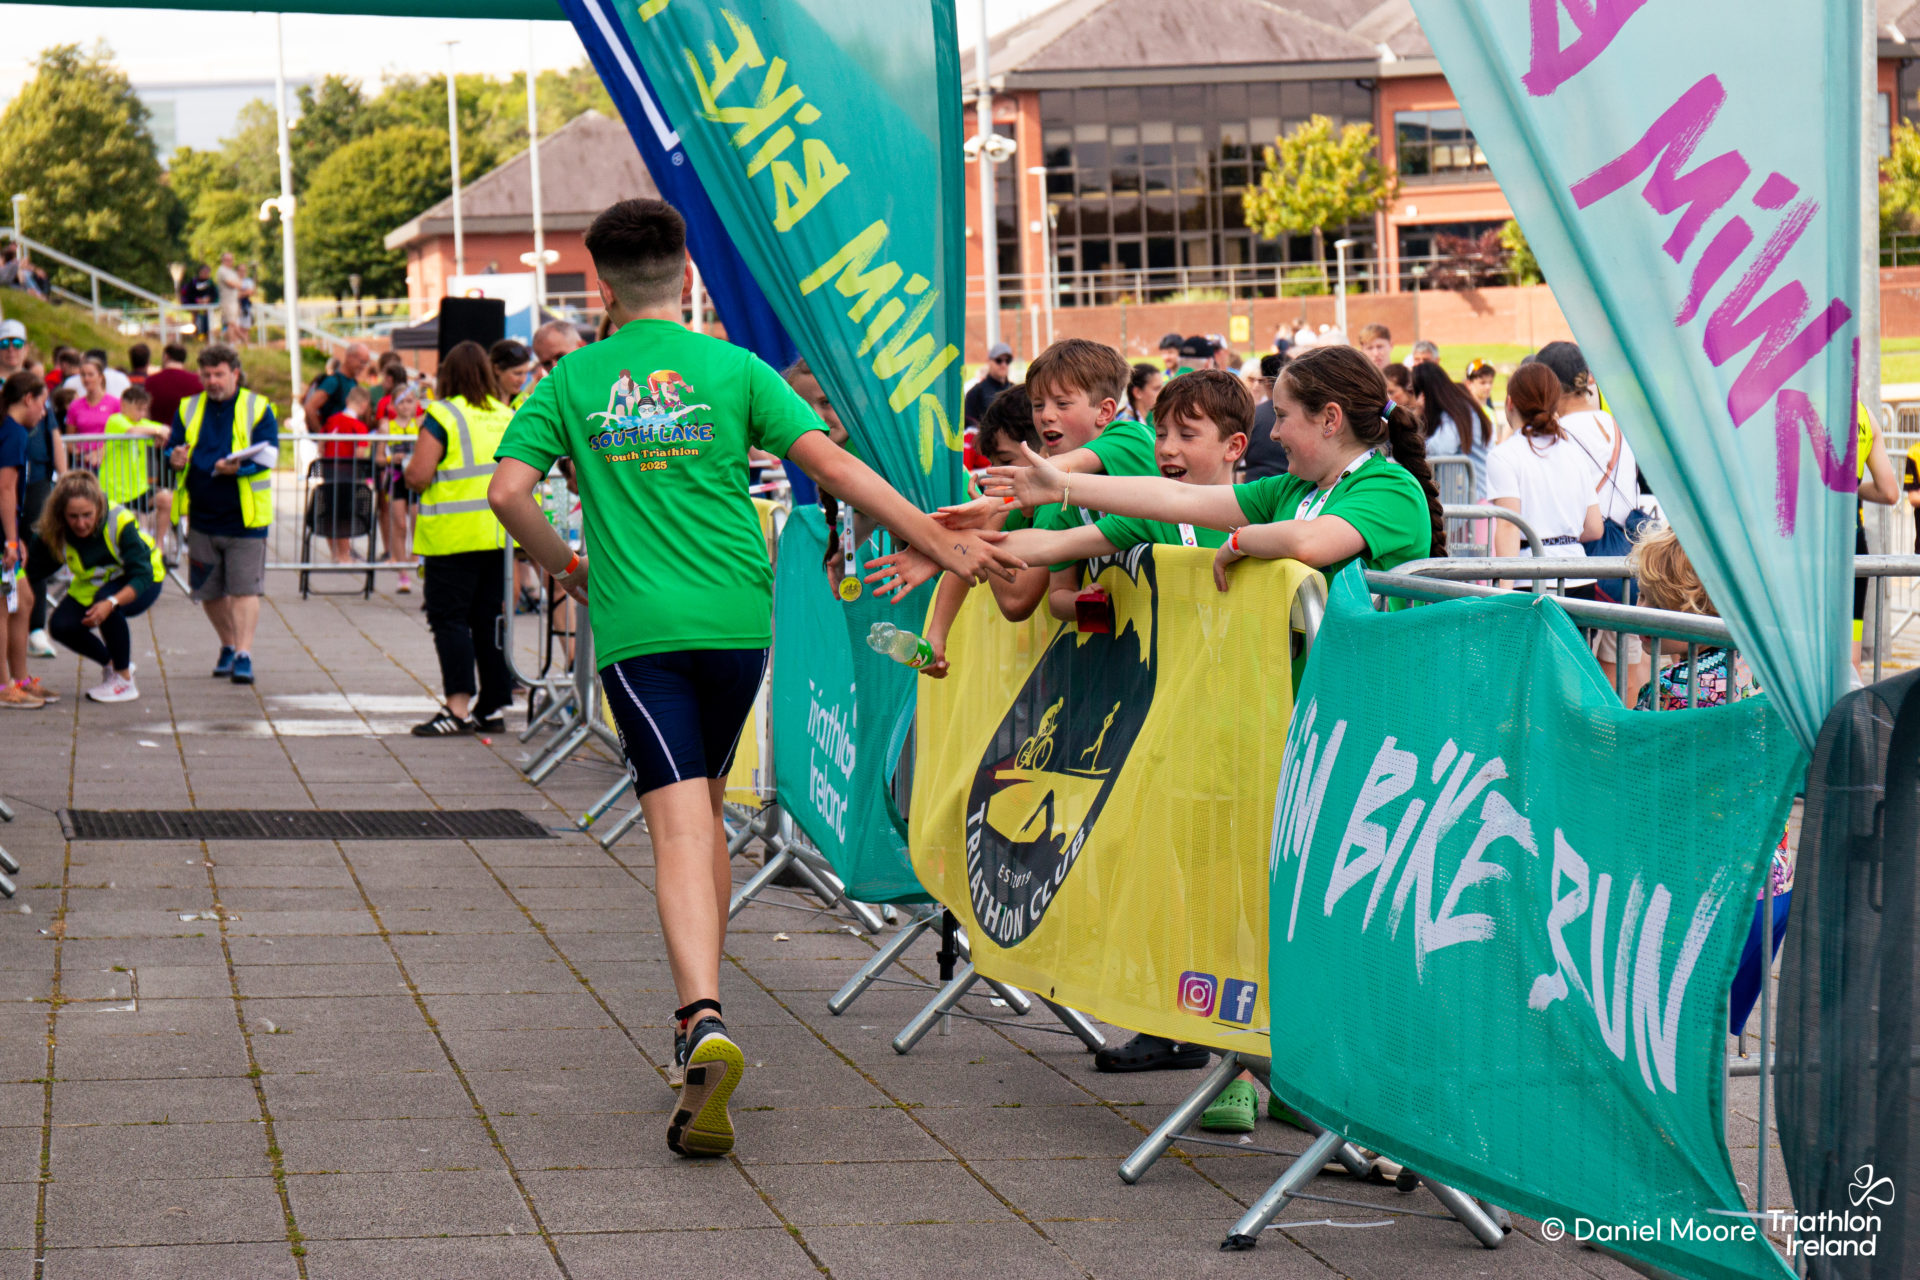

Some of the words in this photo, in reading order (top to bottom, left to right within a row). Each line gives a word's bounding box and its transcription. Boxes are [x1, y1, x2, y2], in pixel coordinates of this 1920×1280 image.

[590, 425, 654, 450] SOUTH
[659, 423, 715, 443] LAKE
[604, 452, 639, 464] Youth
[641, 447, 699, 459] Triathlon
[639, 460, 668, 472] 2025
[967, 800, 1025, 942] TRIATHLON
[1029, 827, 1086, 921] CLUB
[1528, 826, 1735, 1096] RUN
